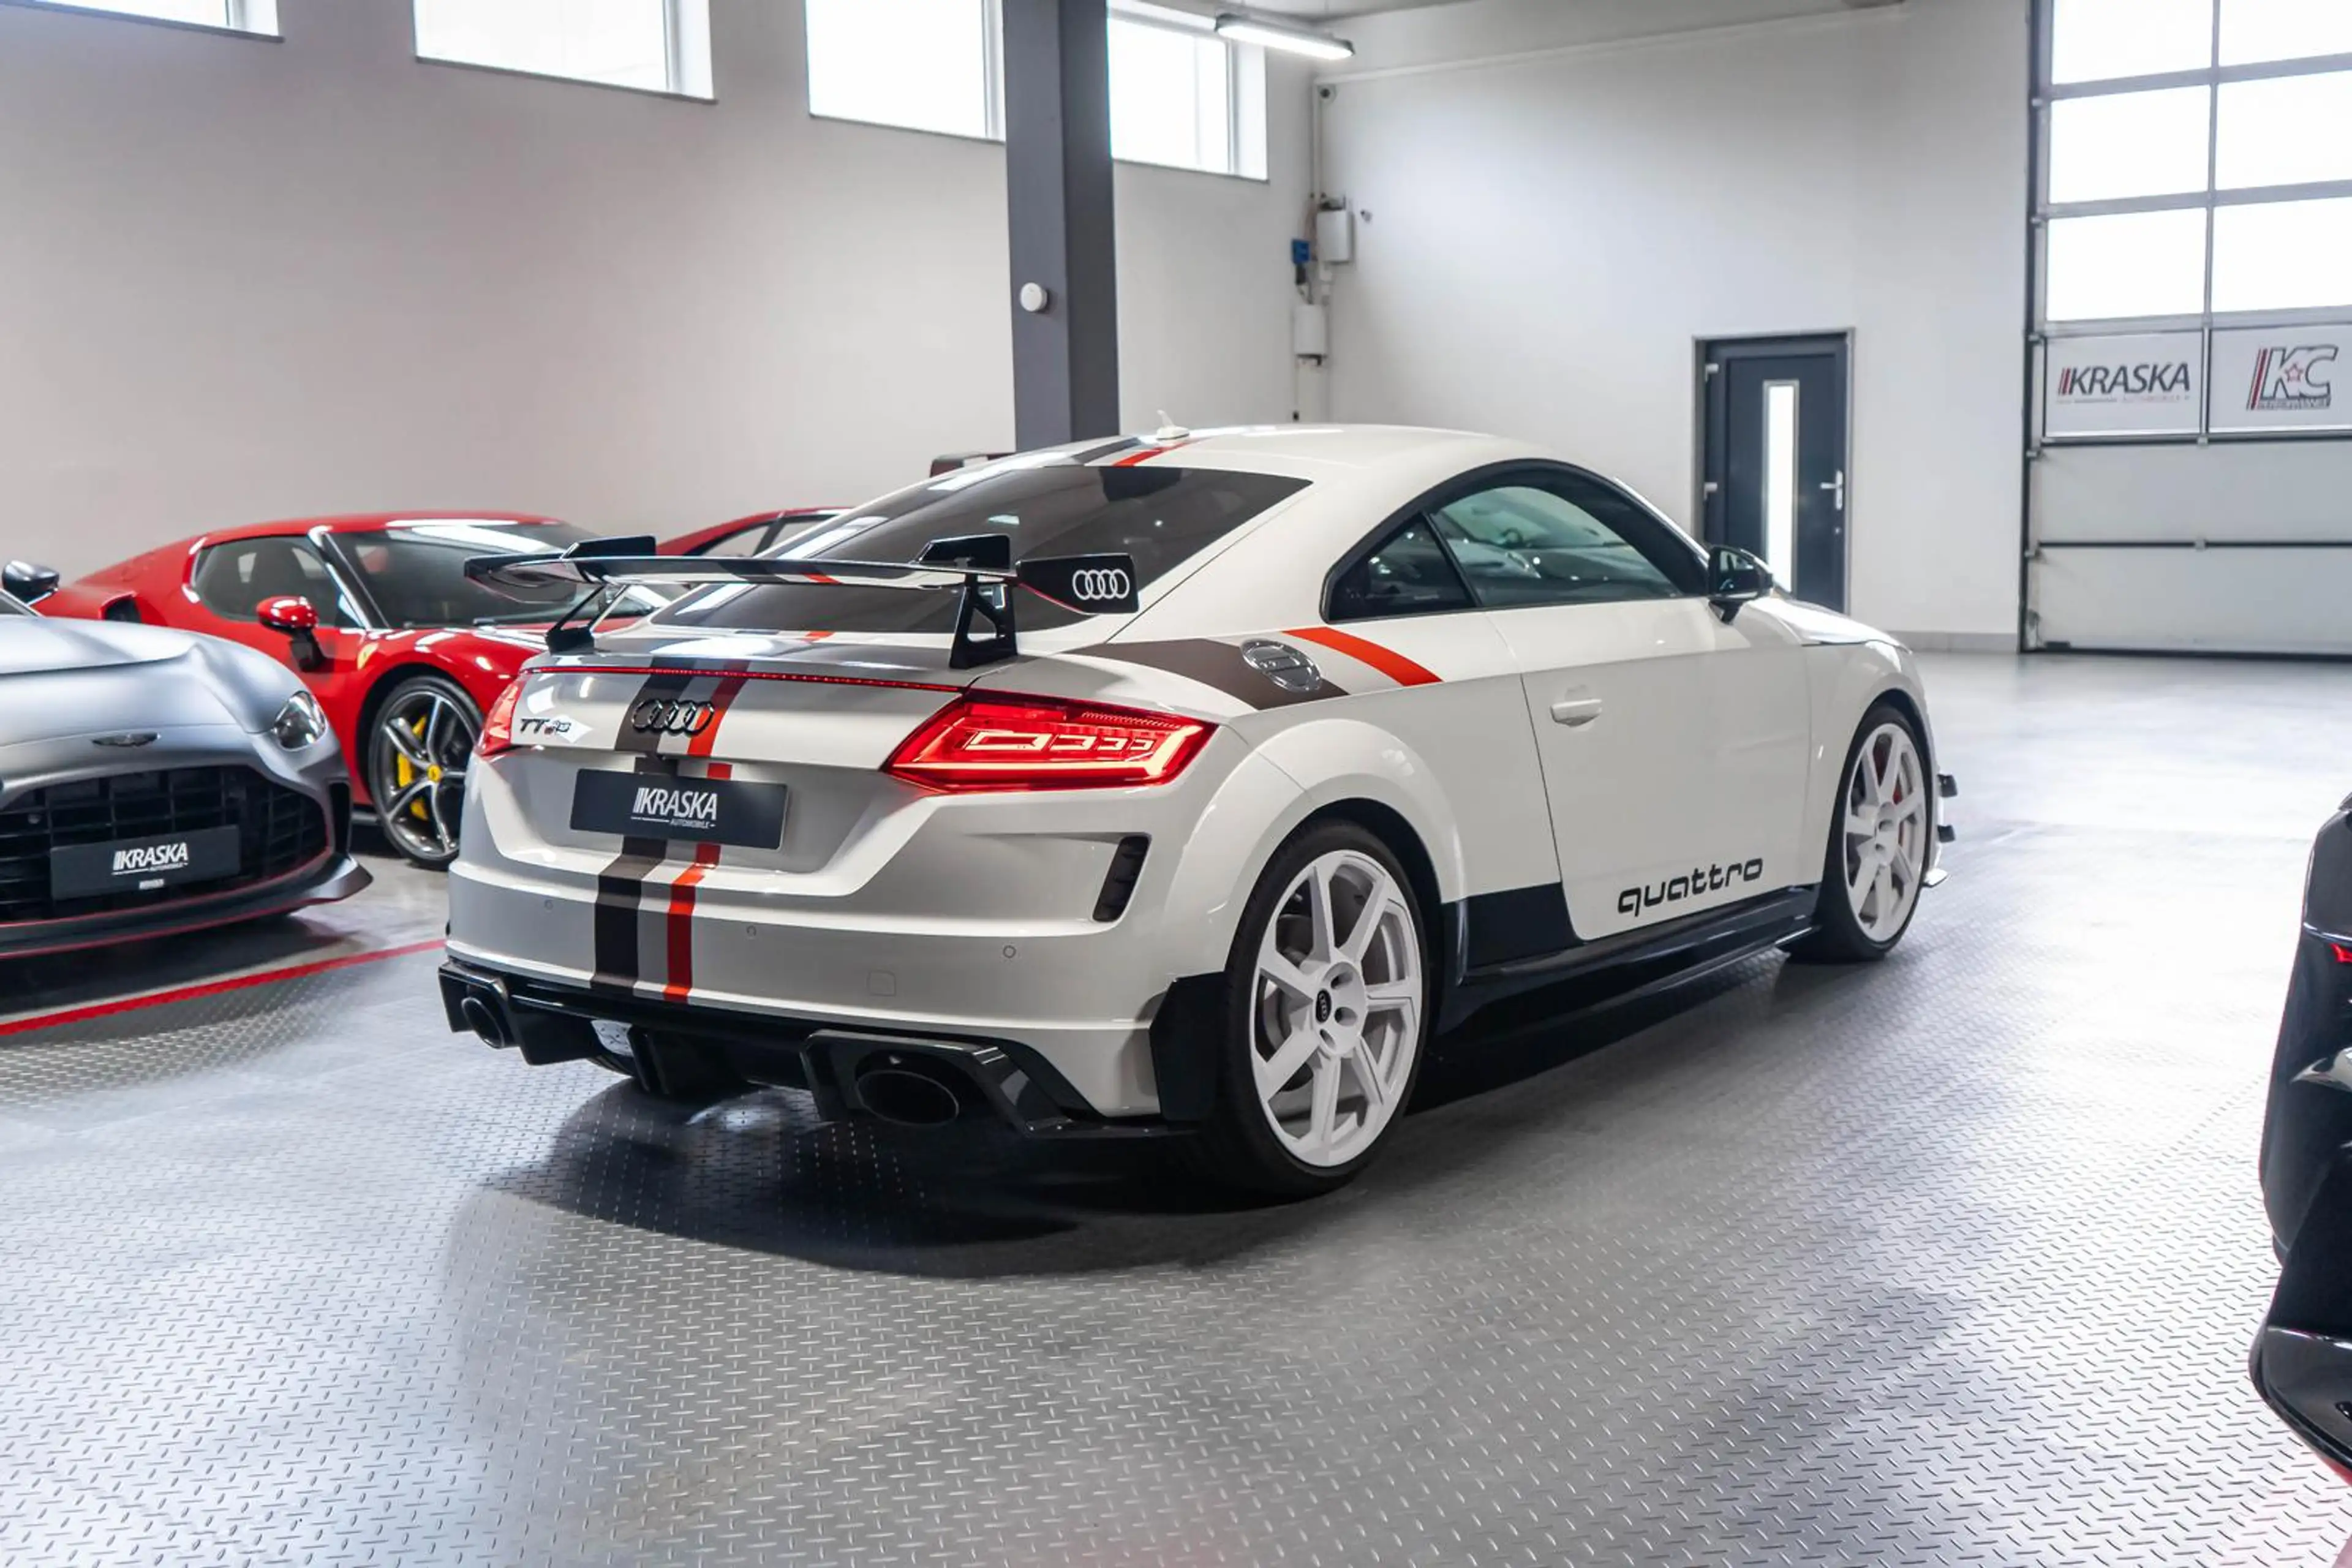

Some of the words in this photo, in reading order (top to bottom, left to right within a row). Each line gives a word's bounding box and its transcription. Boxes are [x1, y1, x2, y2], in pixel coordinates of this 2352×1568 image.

[2068, 363, 2190, 395] KRASKA
[639, 788, 718, 820] KRASKA
[119, 842, 188, 870] KRASKA
[1618, 858, 1763, 917] quattro
